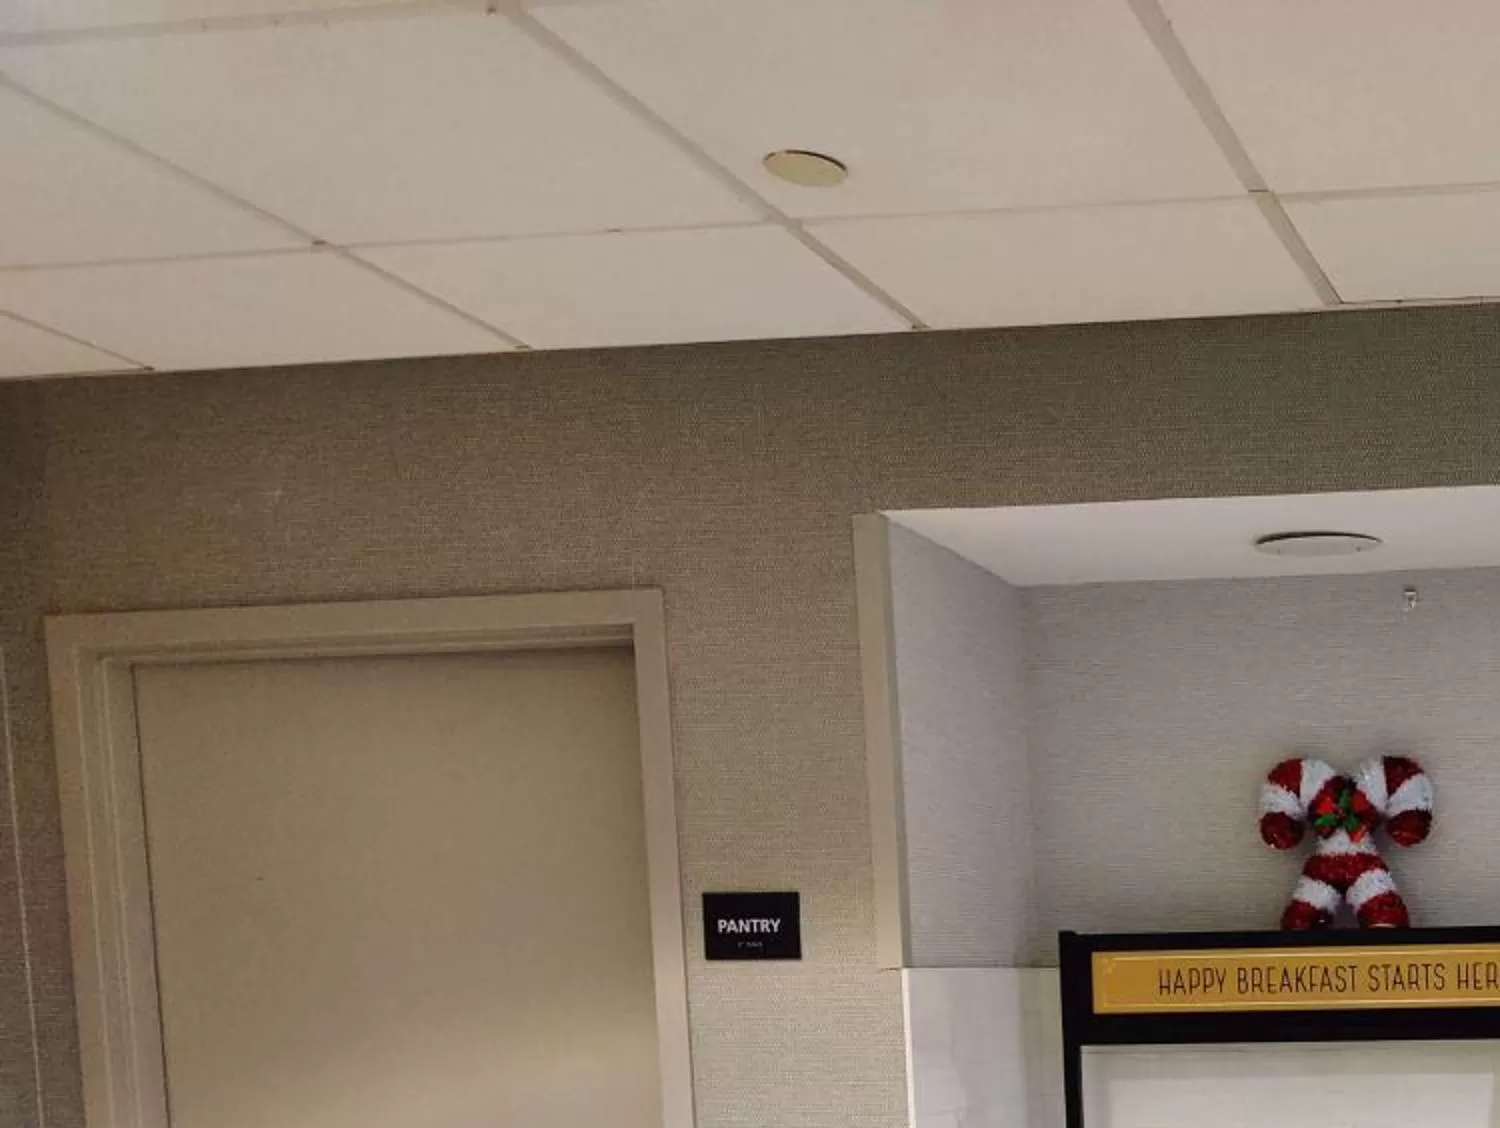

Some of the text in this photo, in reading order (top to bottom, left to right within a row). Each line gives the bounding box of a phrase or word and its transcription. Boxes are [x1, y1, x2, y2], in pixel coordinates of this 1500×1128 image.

[717, 918, 781, 934] PANTRY
[1158, 967, 1227, 996] HAPPY
[1236, 964, 1358, 995] BREAKFAST
[1367, 963, 1446, 992] STARTS
